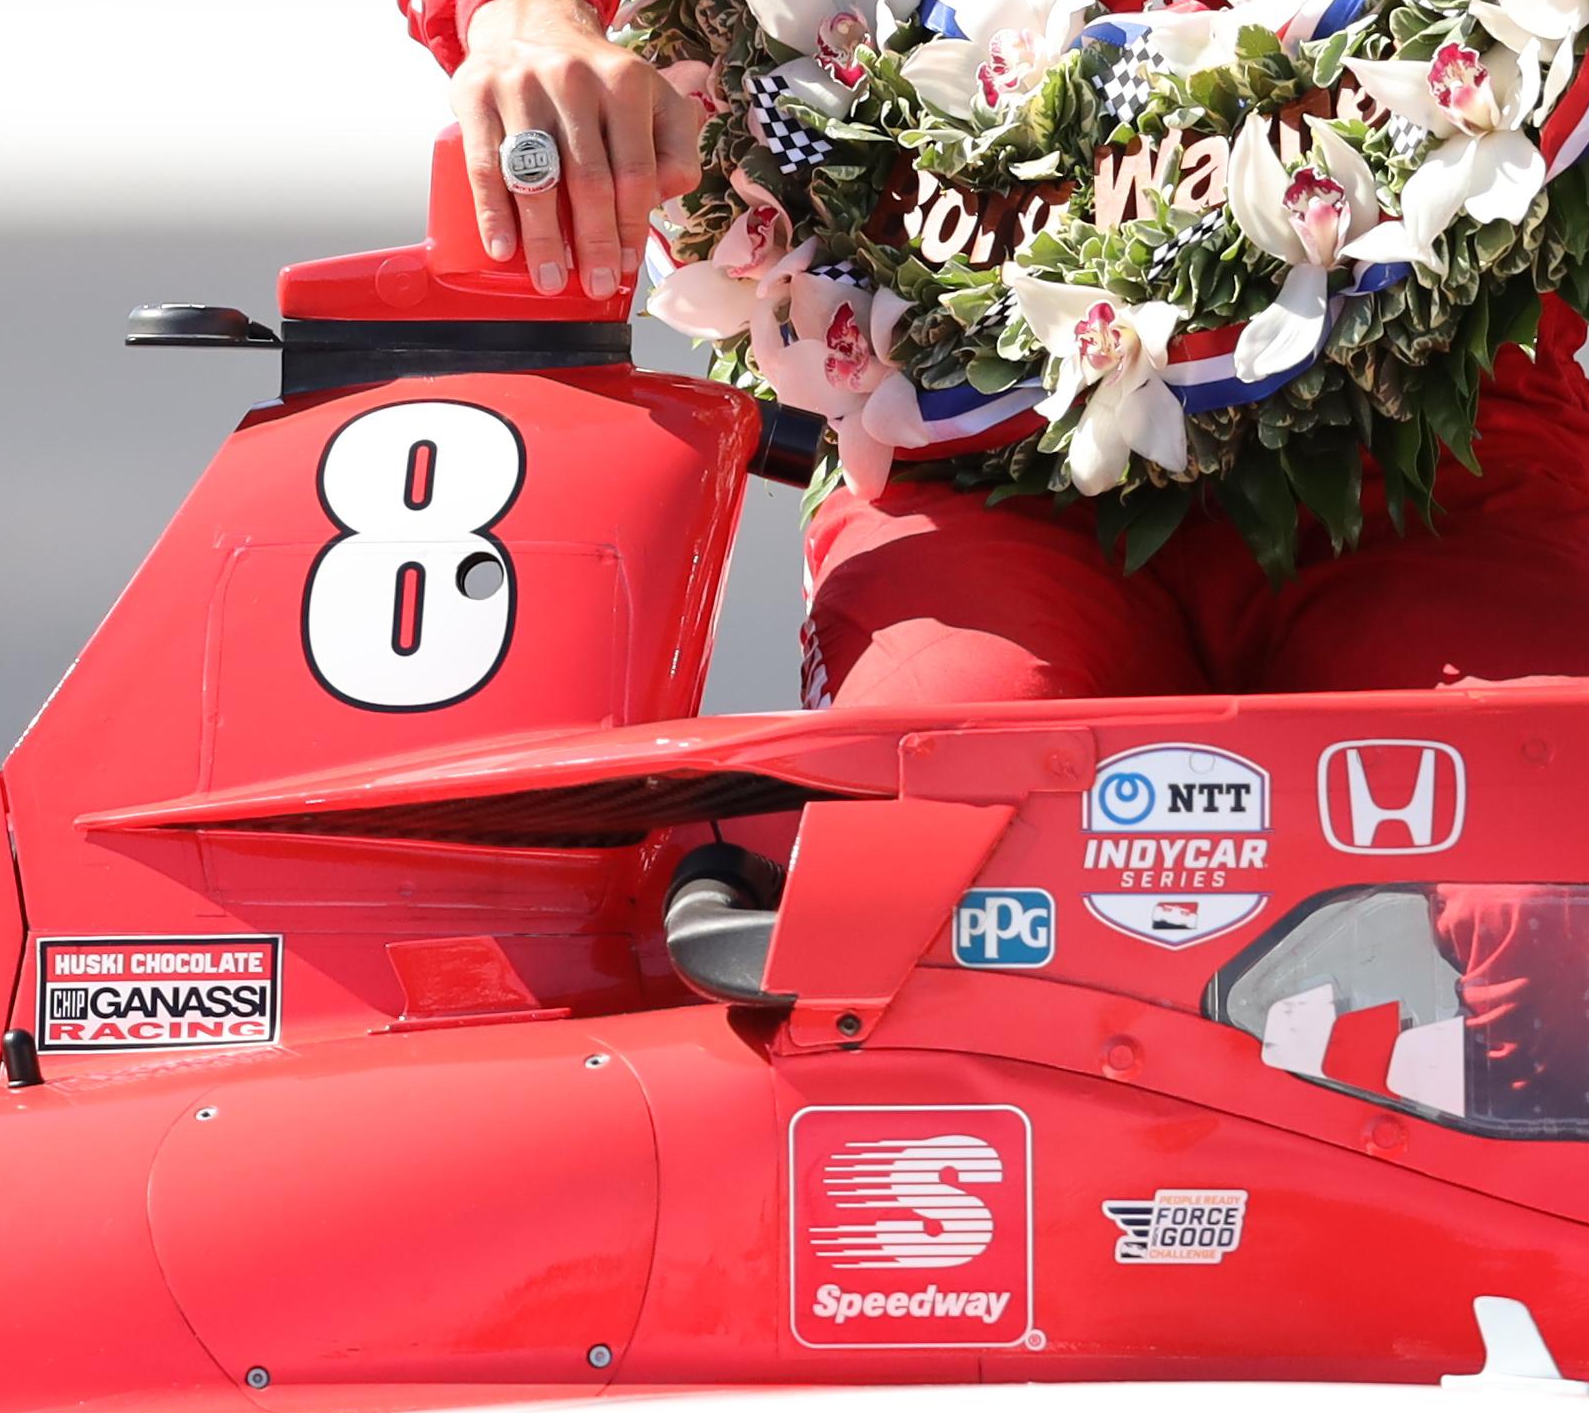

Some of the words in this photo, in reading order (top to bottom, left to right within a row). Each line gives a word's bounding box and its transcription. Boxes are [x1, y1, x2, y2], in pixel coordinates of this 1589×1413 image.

[512, 152, 548, 172] 500
[301, 399, 527, 713] 8
[1167, 782, 1251, 814] NTT
[1083, 838, 1268, 870] INDYCAR
[1120, 870, 1227, 888] SERIES
[959, 895, 1049, 960] PPG
[55, 953, 124, 975] HUSKI
[130, 952, 264, 974] CHOCOLATE
[52, 989, 87, 1018] CHIP
[89, 986, 267, 1019] GANASSI
[49, 1021, 265, 1040] RACING
[1155, 1207, 1240, 1225] FORCE
[1160, 1227, 1235, 1247] GOOD
[813, 1284, 1011, 1324] Speedway
